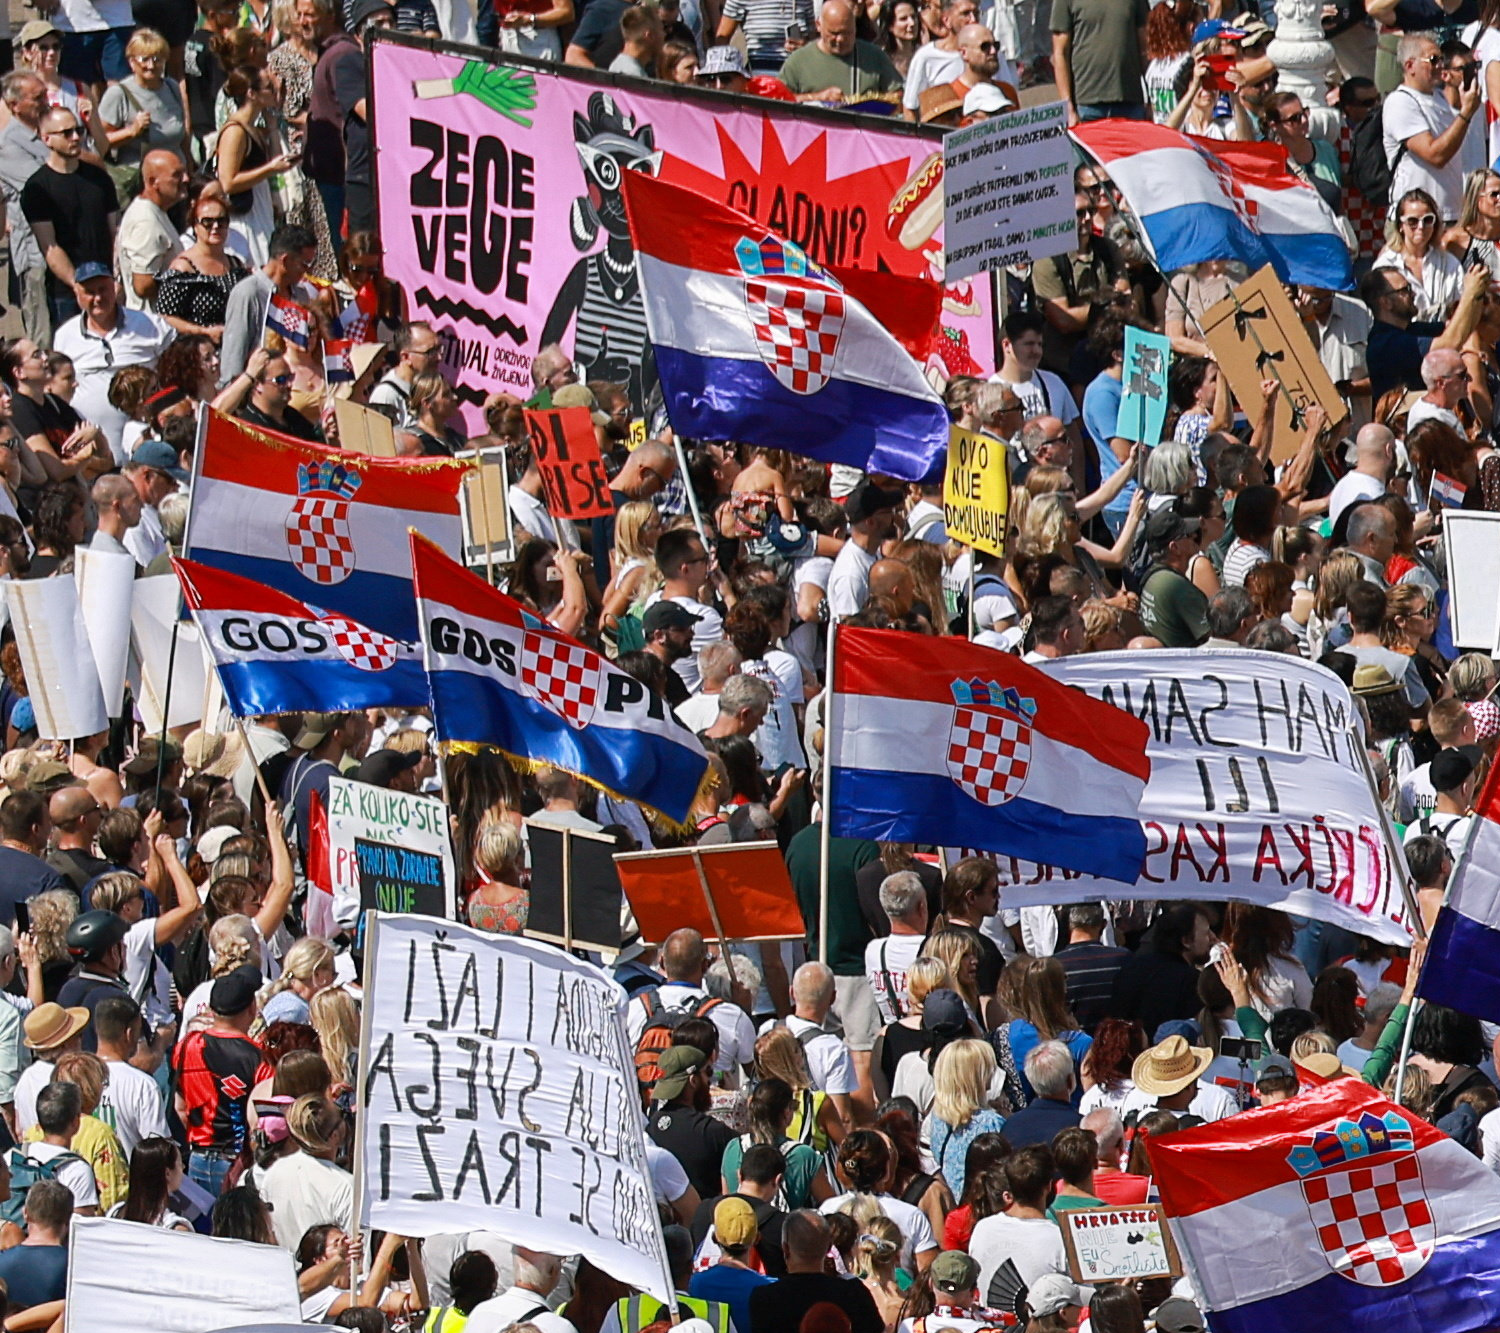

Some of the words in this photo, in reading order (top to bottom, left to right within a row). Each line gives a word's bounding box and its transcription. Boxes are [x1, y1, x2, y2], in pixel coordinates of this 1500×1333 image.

[958, 438, 989, 468] OVO
[951, 470, 982, 500] NIJE
[331, 786, 354, 817] ZA
[1073, 1208, 1160, 1230] HRVATSKA
